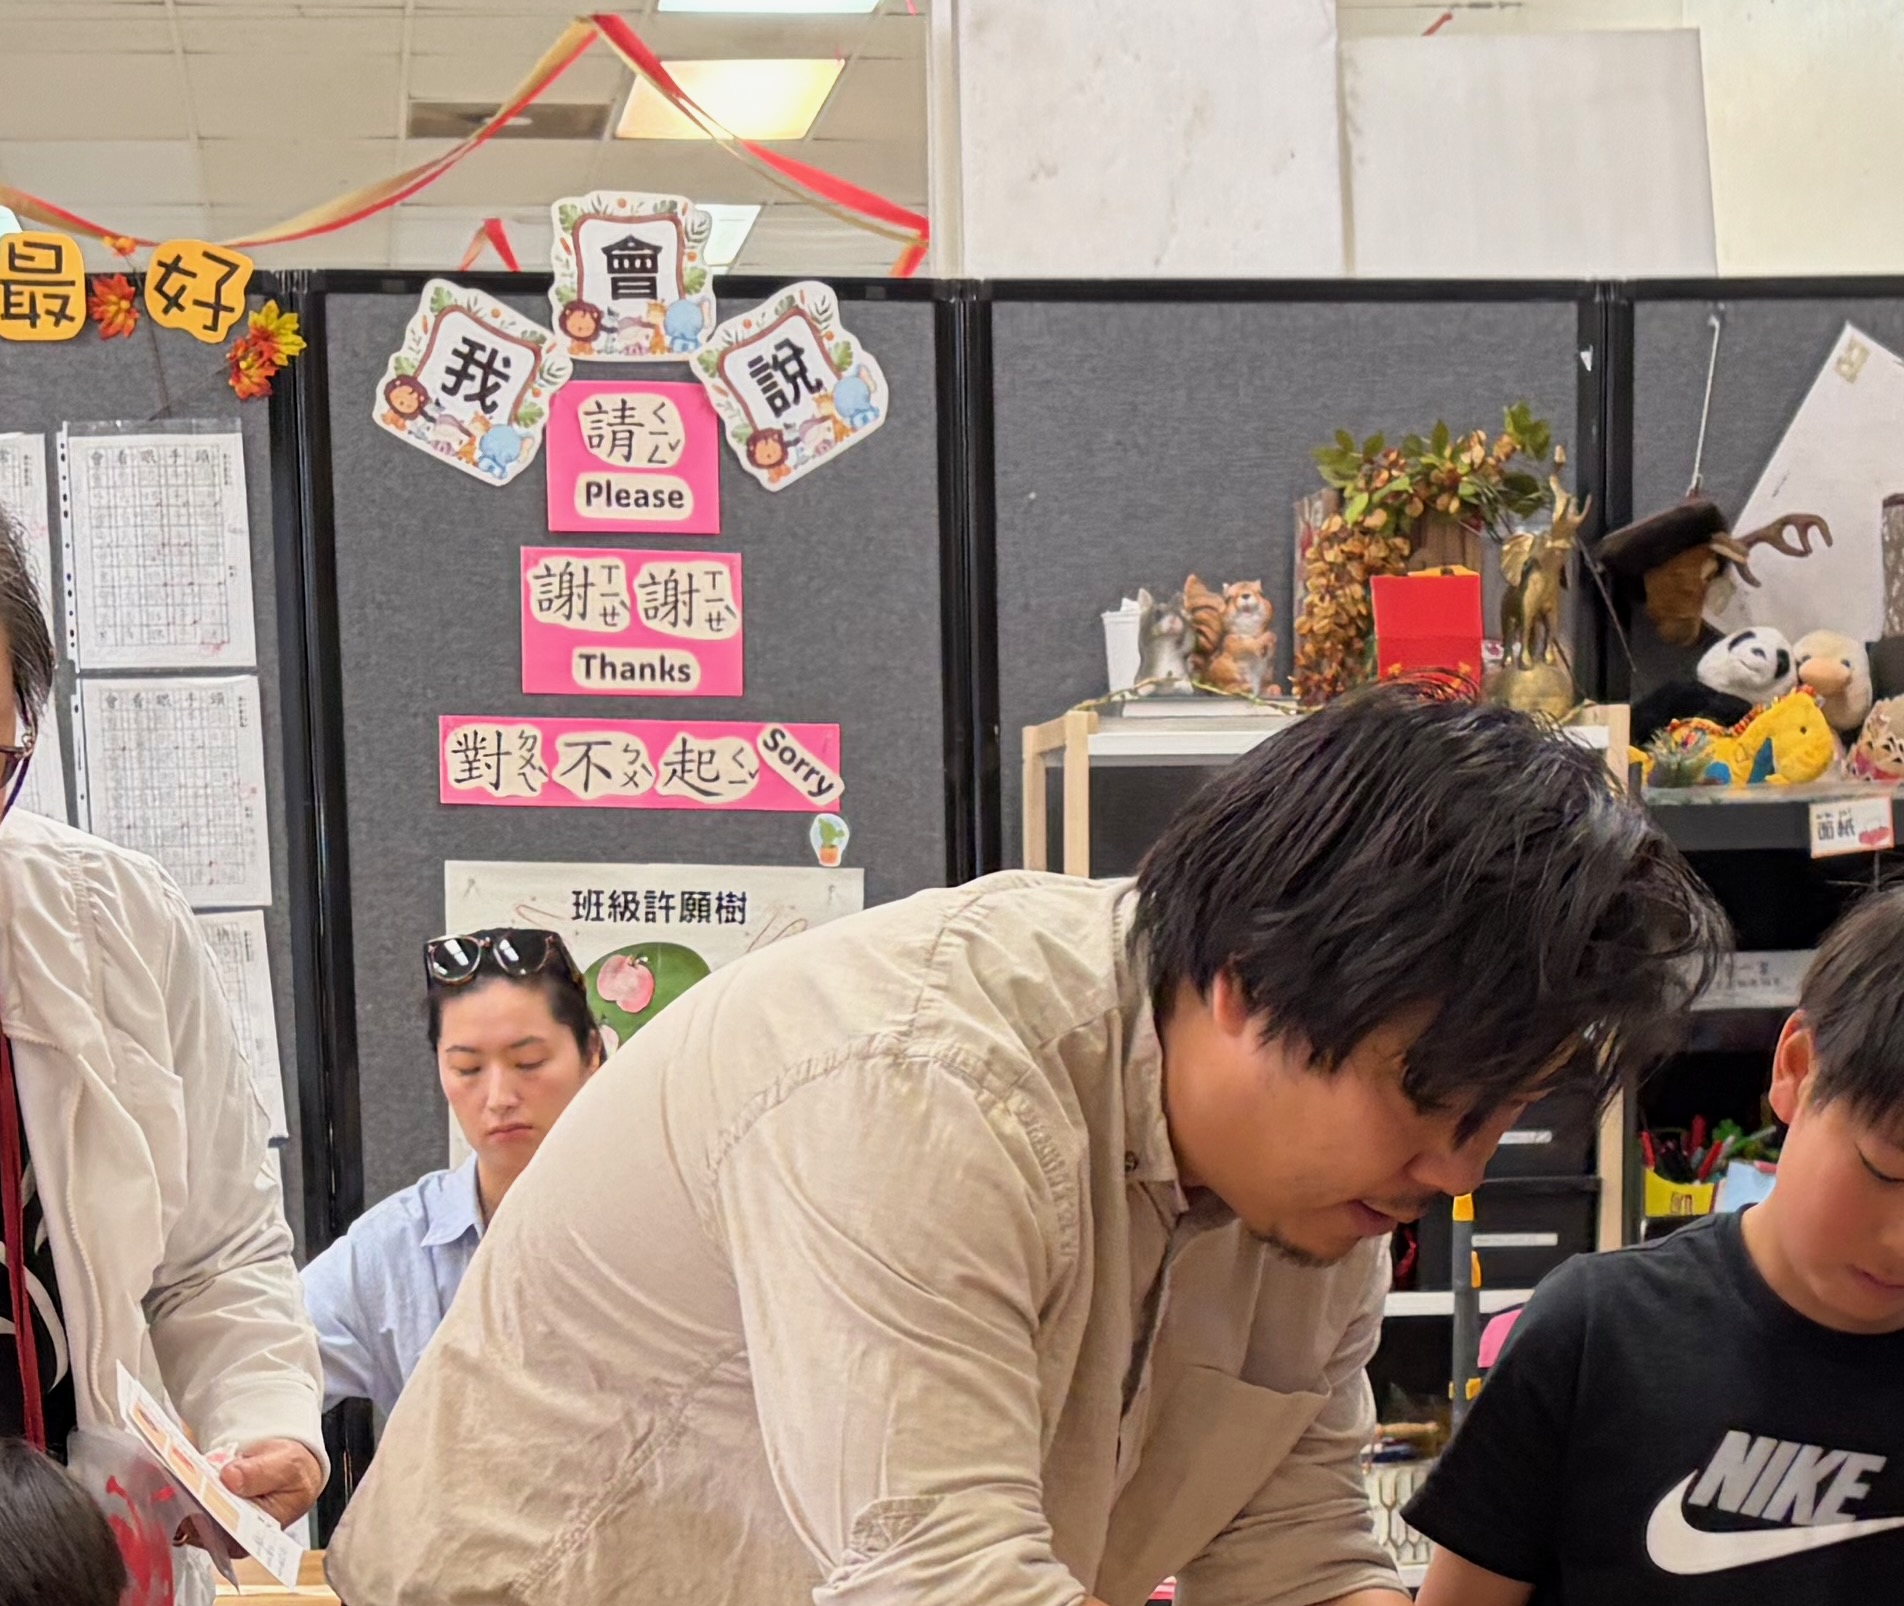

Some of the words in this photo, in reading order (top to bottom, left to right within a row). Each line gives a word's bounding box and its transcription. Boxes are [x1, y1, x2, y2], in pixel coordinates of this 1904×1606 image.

[154, 250, 244, 333] 好
[601, 234, 663, 300] 會
[440, 336, 512, 414] 我
[748, 337, 824, 417] 說
[584, 396, 644, 464] 請
[583, 478, 687, 511] Please
[577, 652, 692, 686] Thanks
[760, 725, 836, 799] Sorry
[570, 887, 748, 926] 班級許願樹
[1687, 1429, 1888, 1526] NIKE
